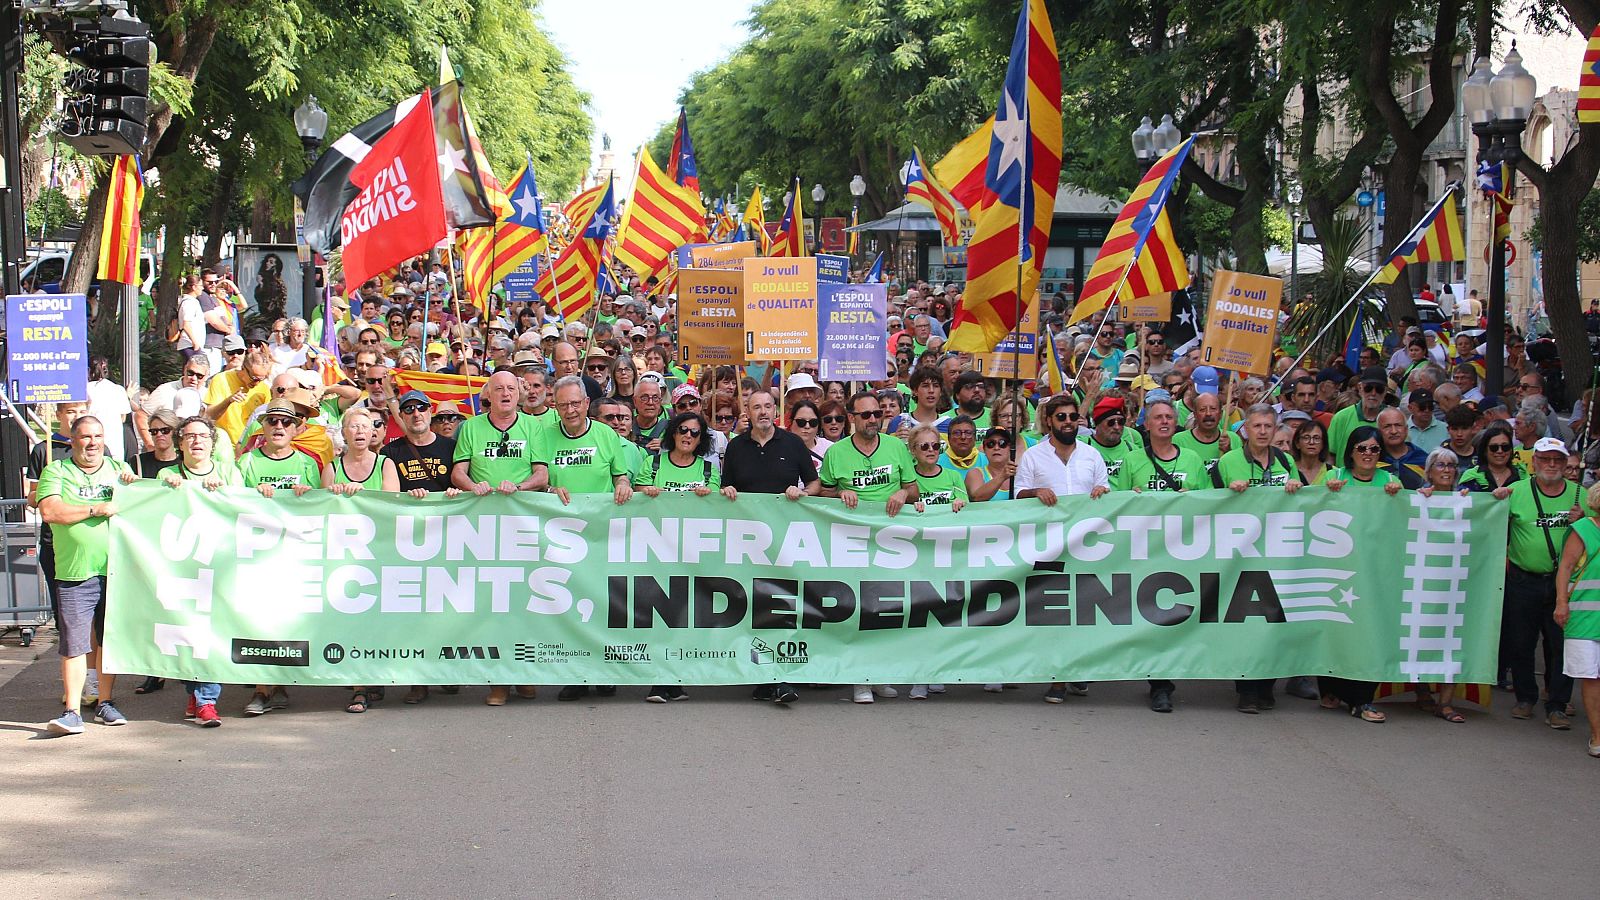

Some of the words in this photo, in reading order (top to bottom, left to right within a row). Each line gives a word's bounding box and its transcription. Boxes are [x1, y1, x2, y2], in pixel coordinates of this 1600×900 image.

[698, 256, 713, 268] 284
[762, 266, 774, 276] Jo
[778, 264, 799, 276] vull
[818, 268, 842, 276] RESTA
[690, 286, 738, 294] l'ESPOLI
[752, 282, 810, 293] RODALIES
[1228, 286, 1241, 296] Jo
[1244, 289, 1266, 300] vull
[832, 293, 874, 302] L'ESPOLI
[20, 298, 72, 312] L'ESPOLI
[758, 298, 814, 311] QUALITAT
[1216, 300, 1274, 320] RODALIES
[702, 308, 736, 317] RESTA
[830, 312, 876, 324] RESTA
[1221, 319, 1269, 334] qualitat
[22, 326, 73, 341] RESTA
[485, 449, 494, 457] EL
[555, 457, 565, 465] EL
[852, 478, 863, 486] EL
[1548, 519, 1568, 528] CAM
[235, 512, 377, 560] PER
[394, 514, 588, 564] UNES
[607, 510, 1354, 569] INFRAESTRUCTURES
[240, 646, 302, 658] assemblea
[350, 646, 425, 659] ÒMNIUM
[556, 650, 590, 658] República
[777, 642, 808, 657] CDR
